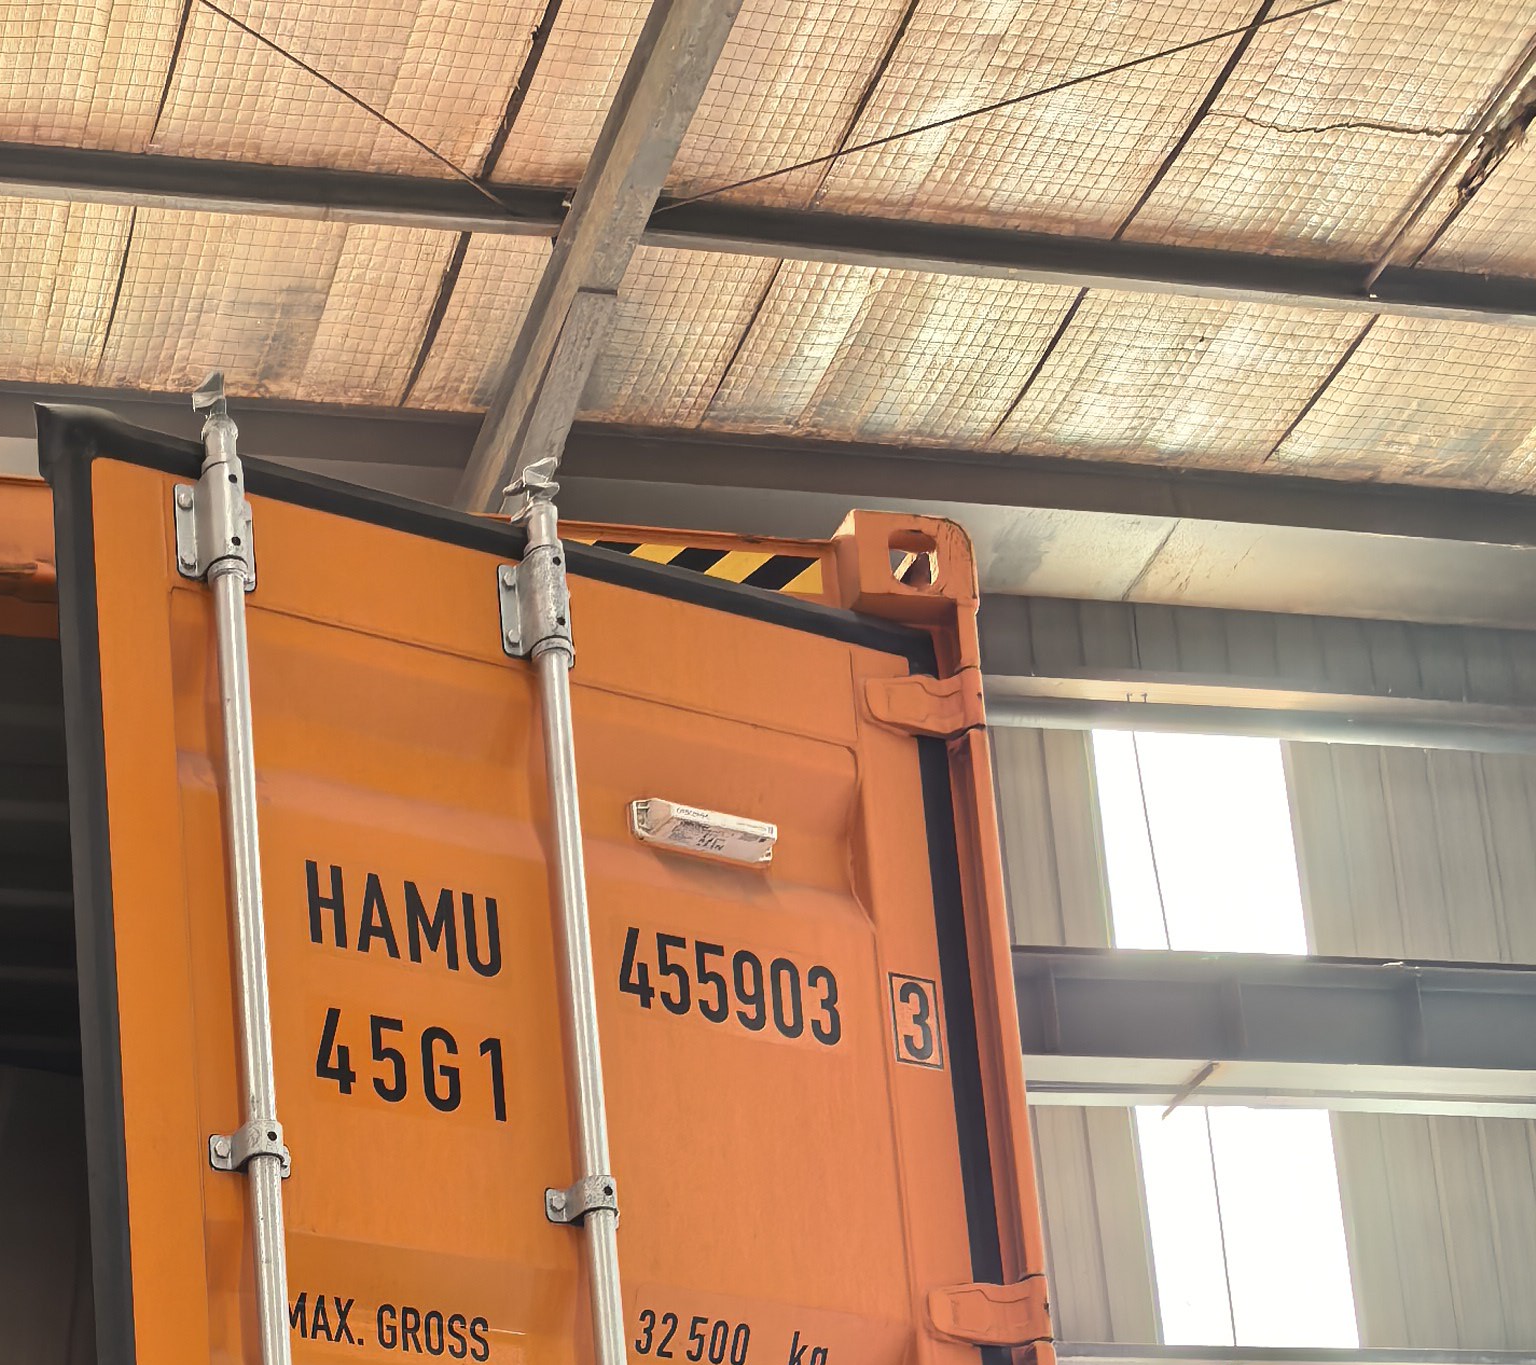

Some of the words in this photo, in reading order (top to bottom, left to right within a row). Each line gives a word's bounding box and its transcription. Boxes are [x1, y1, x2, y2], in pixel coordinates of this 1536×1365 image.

[305, 859, 502, 978] HAMU
[619, 926, 841, 1046] 455903
[898, 982, 933, 1061] 3
[316, 1007, 507, 1122] 45G1
[288, 1291, 364, 1346] MAX.
[376, 1303, 490, 1362] GROSS
